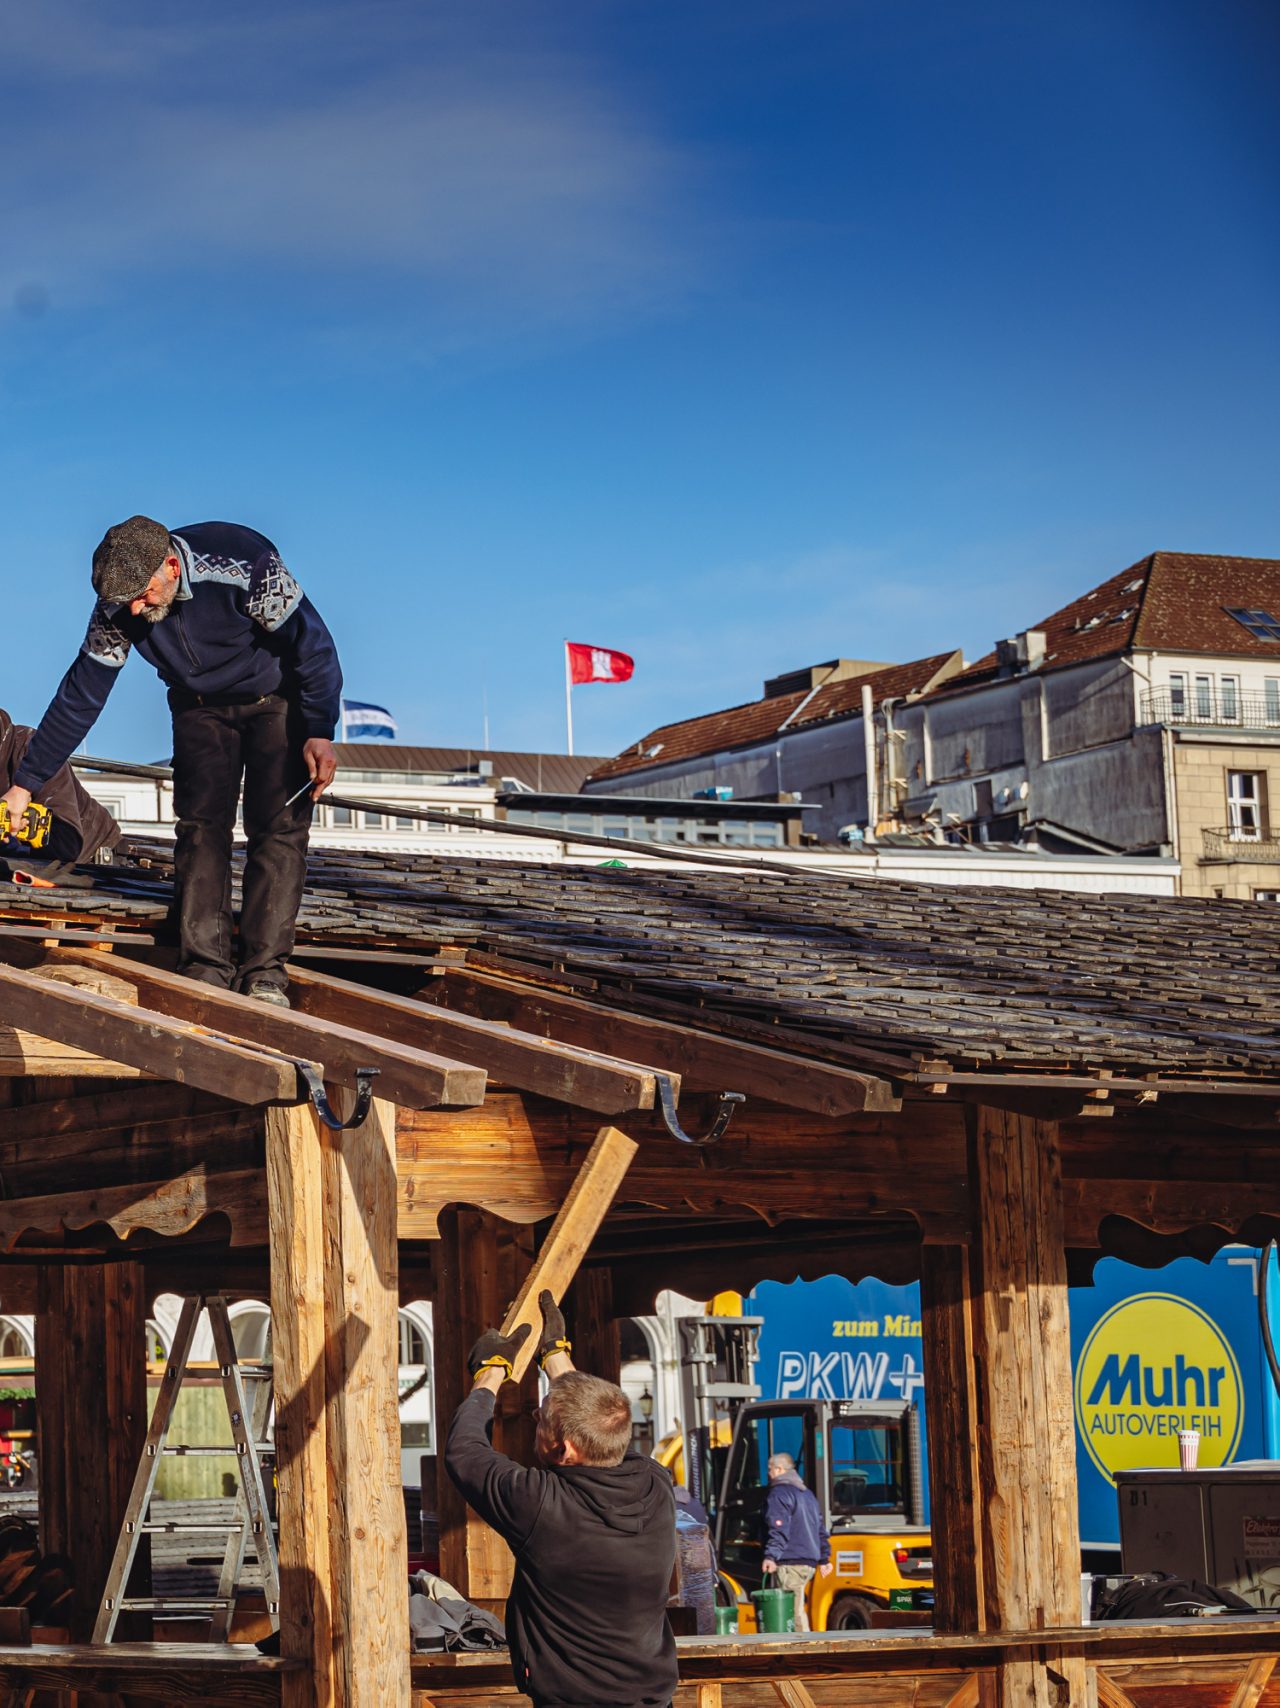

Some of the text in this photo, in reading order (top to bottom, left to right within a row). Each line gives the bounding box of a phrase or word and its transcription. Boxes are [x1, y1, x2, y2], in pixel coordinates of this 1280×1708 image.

[832, 1314, 923, 1337] zum Min
[776, 1351, 925, 1400] PKW+
[1086, 1353, 1226, 1407] Muhr
[690, 1432, 700, 1499] UNGHEINRICH
